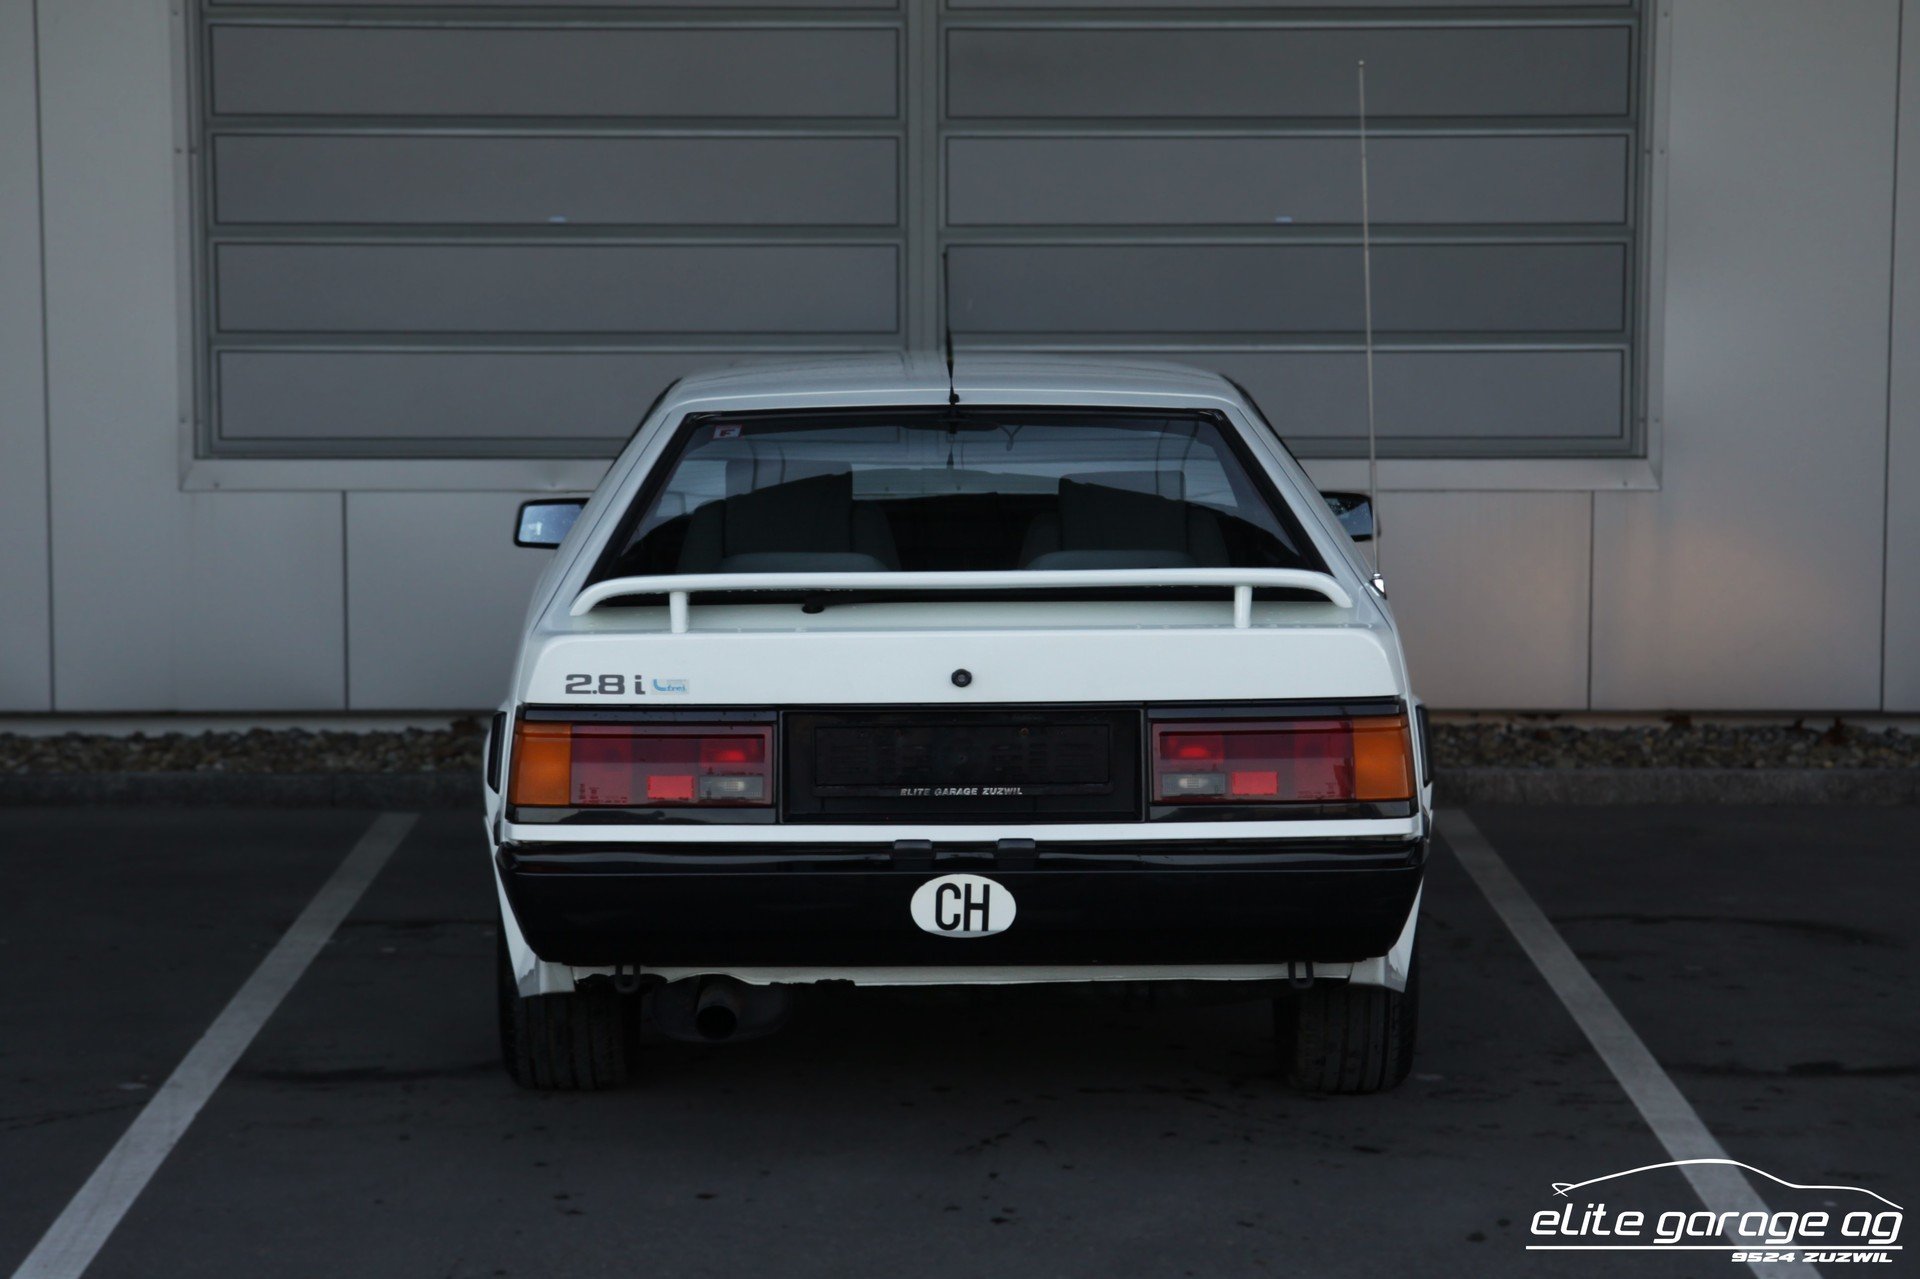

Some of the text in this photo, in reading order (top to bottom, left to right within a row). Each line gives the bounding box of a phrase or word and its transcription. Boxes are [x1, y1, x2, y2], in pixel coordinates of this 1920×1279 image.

[565, 674, 646, 695] 2.8 i
[900, 786, 1023, 796] ELITE GARAGE ZUZWIL
[935, 882, 990, 931] CH
